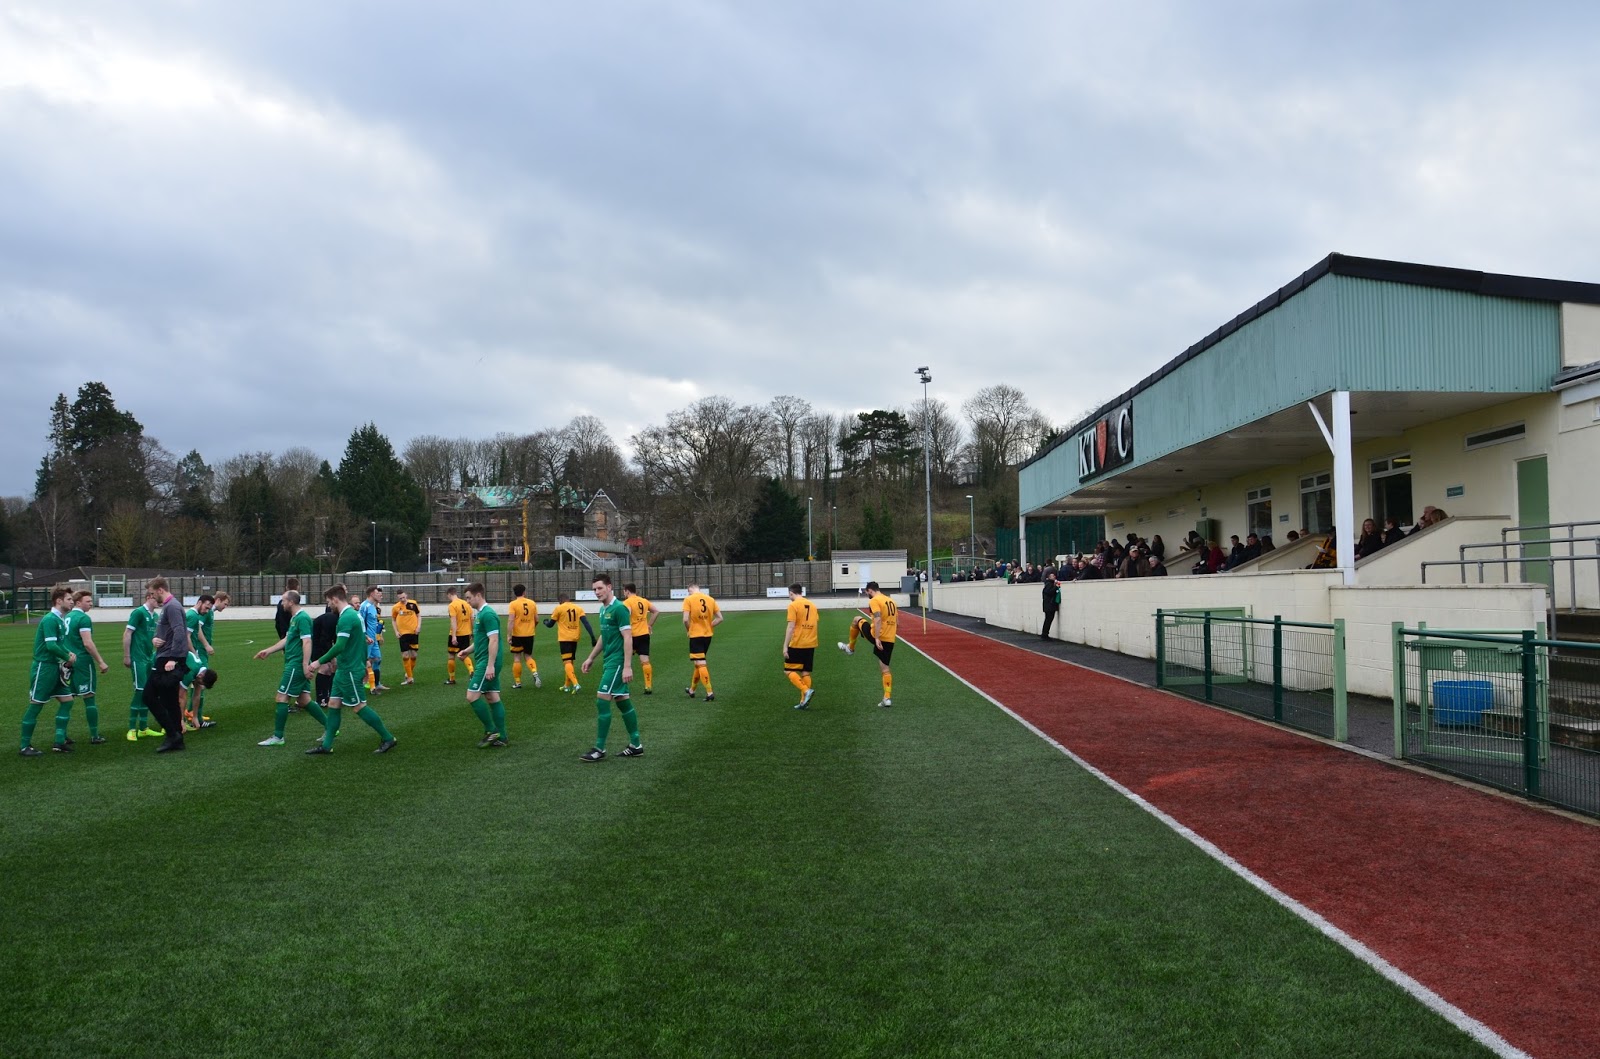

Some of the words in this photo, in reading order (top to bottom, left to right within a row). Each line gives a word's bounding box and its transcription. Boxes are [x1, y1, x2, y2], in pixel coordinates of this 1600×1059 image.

[462, 604, 467, 616] 4
[523, 603, 529, 616] 5
[638, 602, 644, 615] 9
[700, 599, 707, 613] 3
[805, 605, 810, 620] 7
[885, 601, 896, 616] 10
[566, 609, 577, 622] 11
